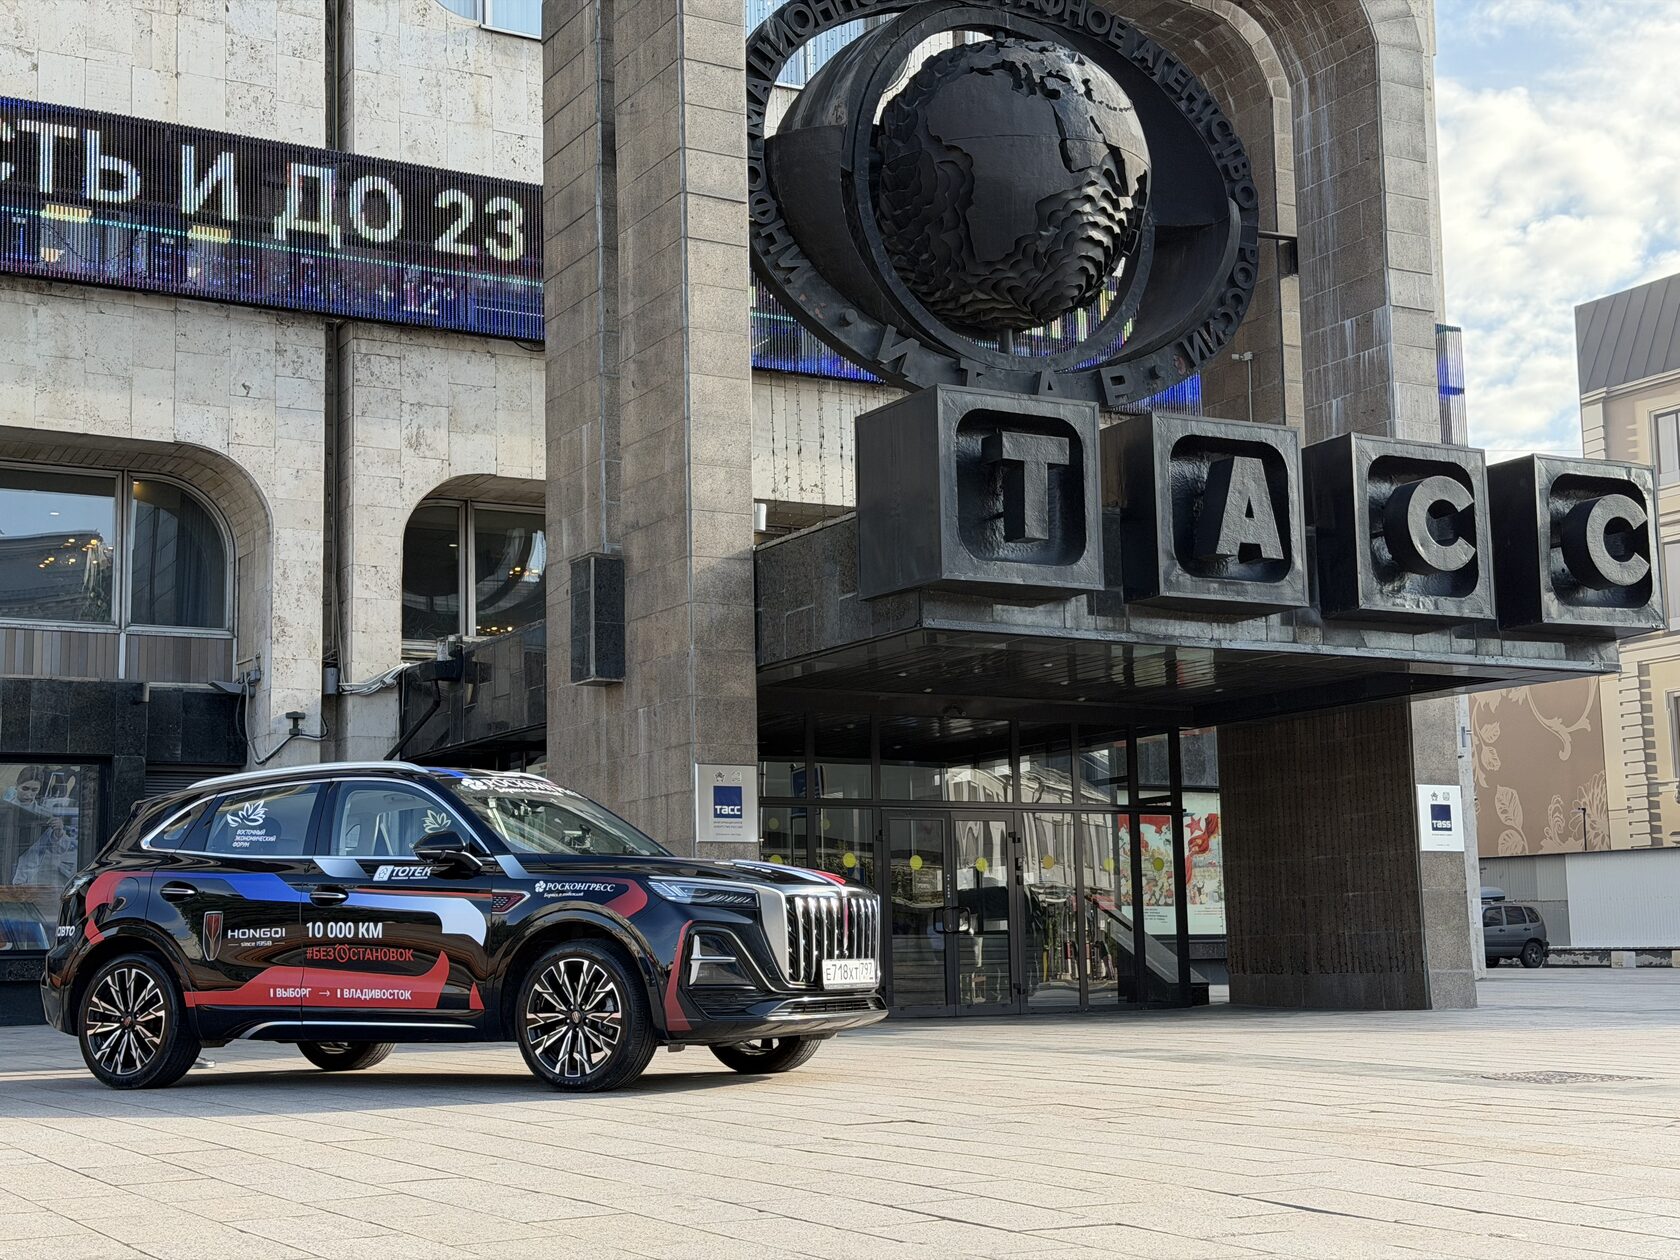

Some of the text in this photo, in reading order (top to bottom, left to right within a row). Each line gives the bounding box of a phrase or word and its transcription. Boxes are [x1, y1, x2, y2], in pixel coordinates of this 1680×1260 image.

[181, 145, 238, 221] И
[274, 162, 403, 248] ДО
[434, 189, 523, 262] 23
[983, 429, 1650, 586] ТАСС
[546, 882, 616, 892] РОСКОНГРЕСС
[227, 928, 286, 939] HONGQI
[306, 922, 323, 938] 10
[327, 922, 355, 938] 000
[276, 987, 412, 1000] ВЫБОРГ ВЛАДИВОСТОК
